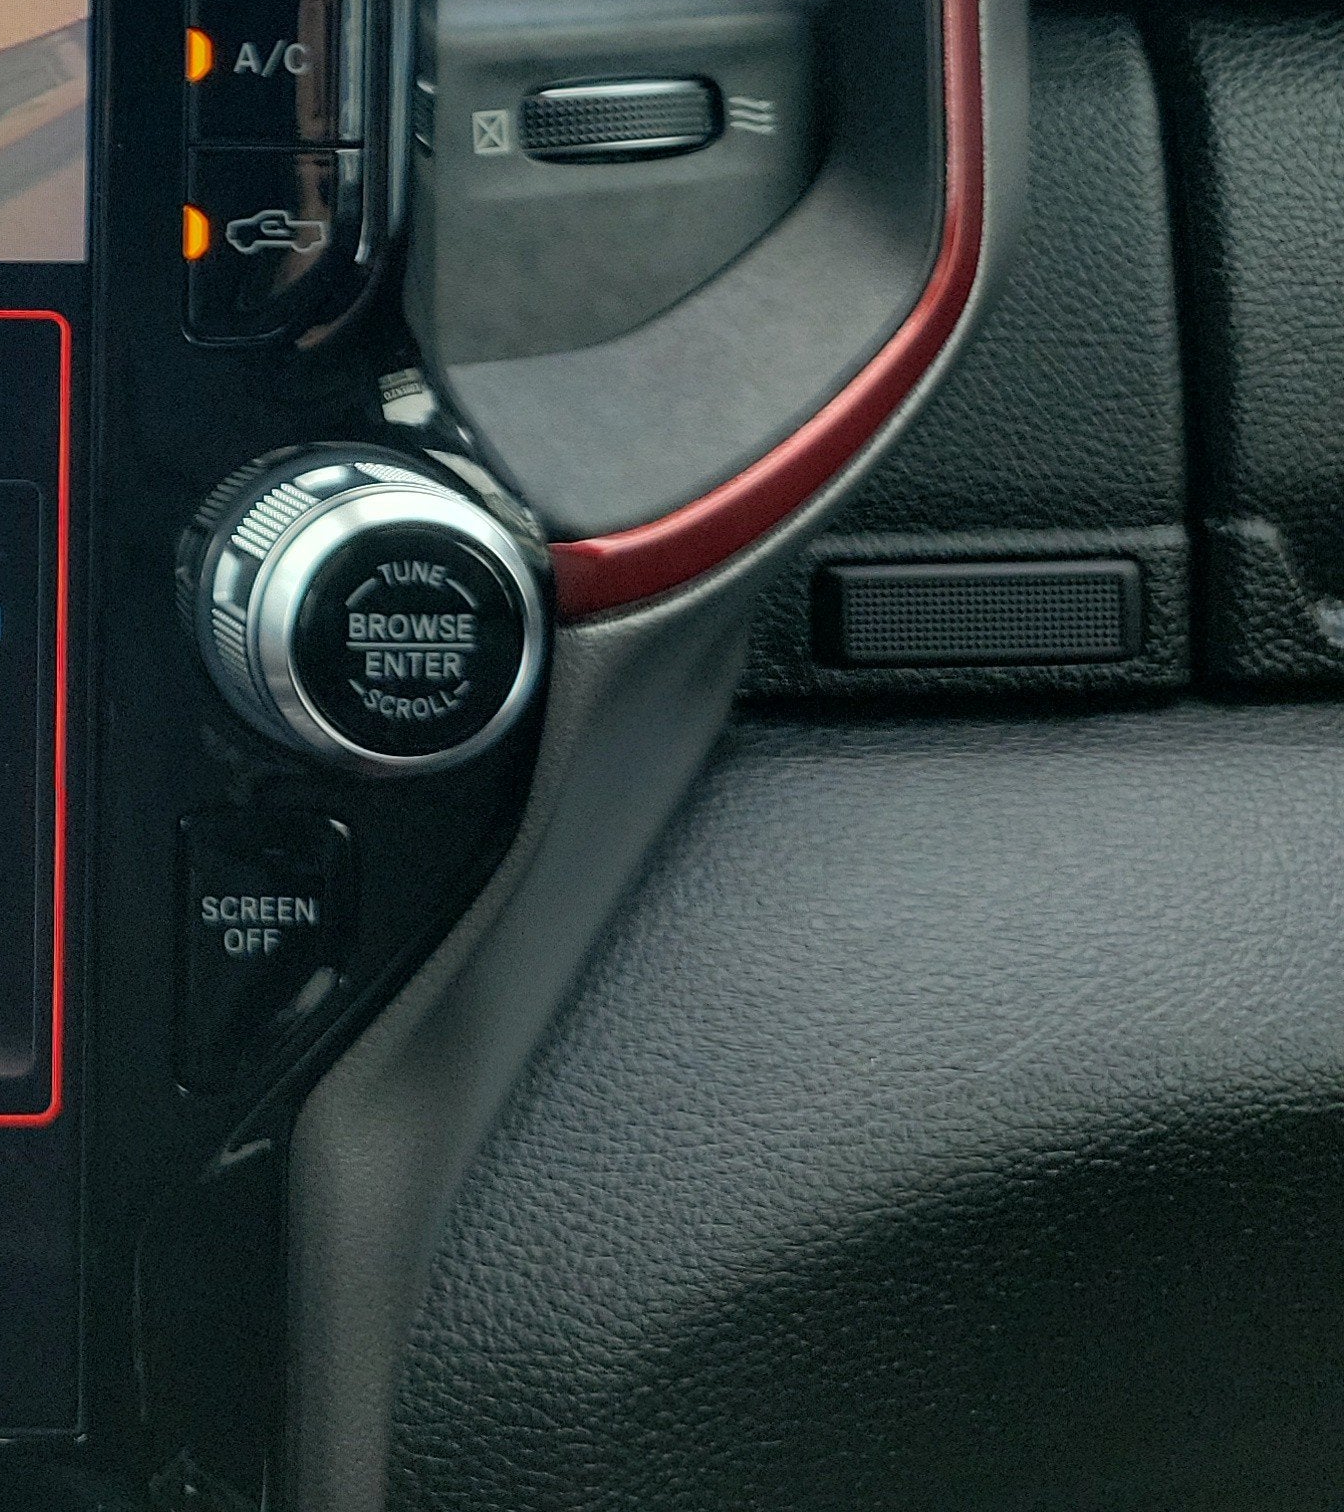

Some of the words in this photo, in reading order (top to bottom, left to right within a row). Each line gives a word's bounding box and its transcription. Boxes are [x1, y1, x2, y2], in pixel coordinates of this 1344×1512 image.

[234, 39, 308, 76] A/C
[376, 560, 448, 587] TUNE
[348, 613, 475, 640] BROWSE
[365, 652, 464, 678] ENTER
[362, 689, 459, 720] SCROLL
[201, 896, 316, 925] SCREEN
[223, 928, 282, 955] OFF
